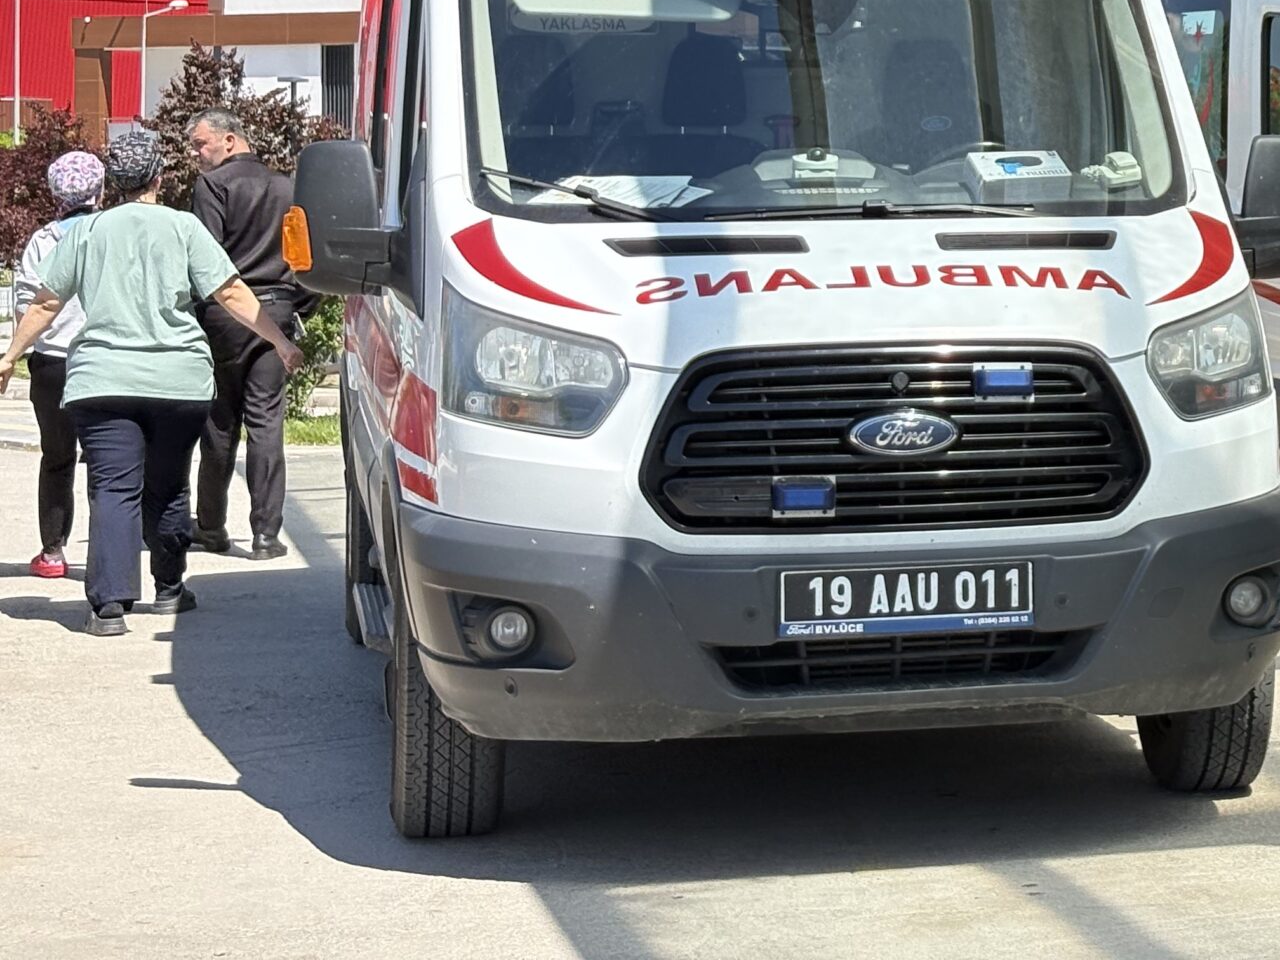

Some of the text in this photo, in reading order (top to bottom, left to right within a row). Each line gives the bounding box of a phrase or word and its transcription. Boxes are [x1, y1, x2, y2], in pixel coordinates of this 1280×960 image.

[539, 16, 627, 32] YAKLAŞMA
[874, 418, 934, 447] Ford
[809, 568, 1019, 616] 19 AAU 011
